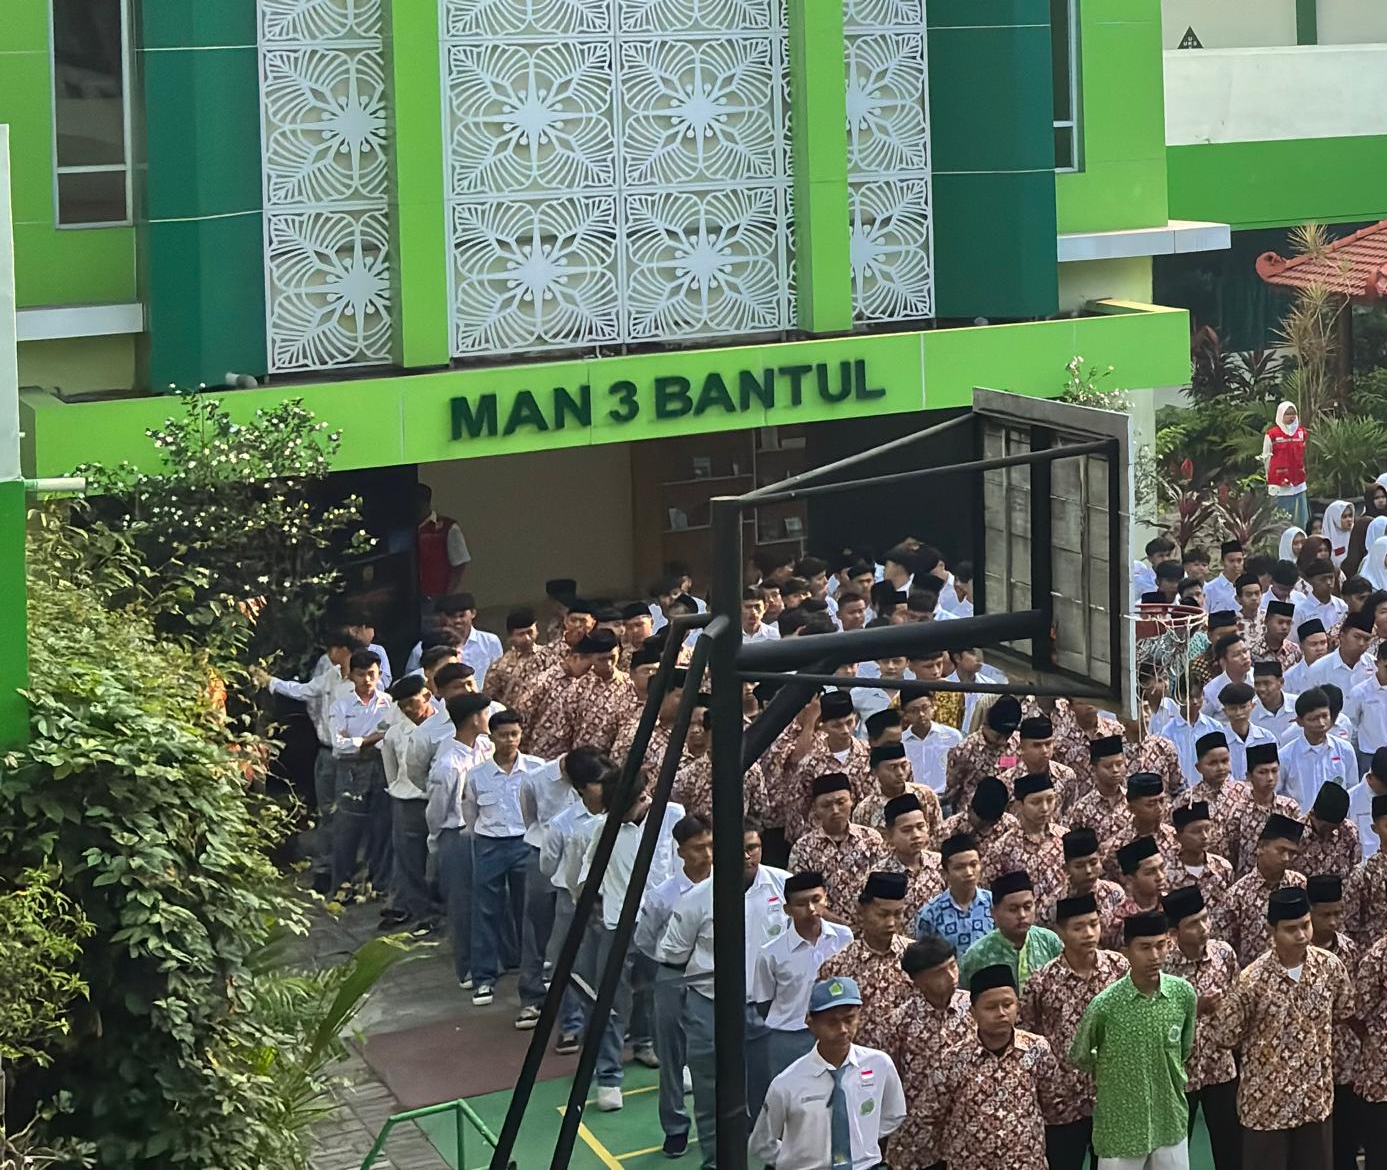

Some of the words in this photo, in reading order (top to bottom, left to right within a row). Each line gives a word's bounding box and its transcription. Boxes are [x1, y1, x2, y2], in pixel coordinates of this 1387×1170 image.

[450, 384, 592, 441] MAN
[608, 380, 640, 423] 3
[654, 359, 886, 421] BANTUL
